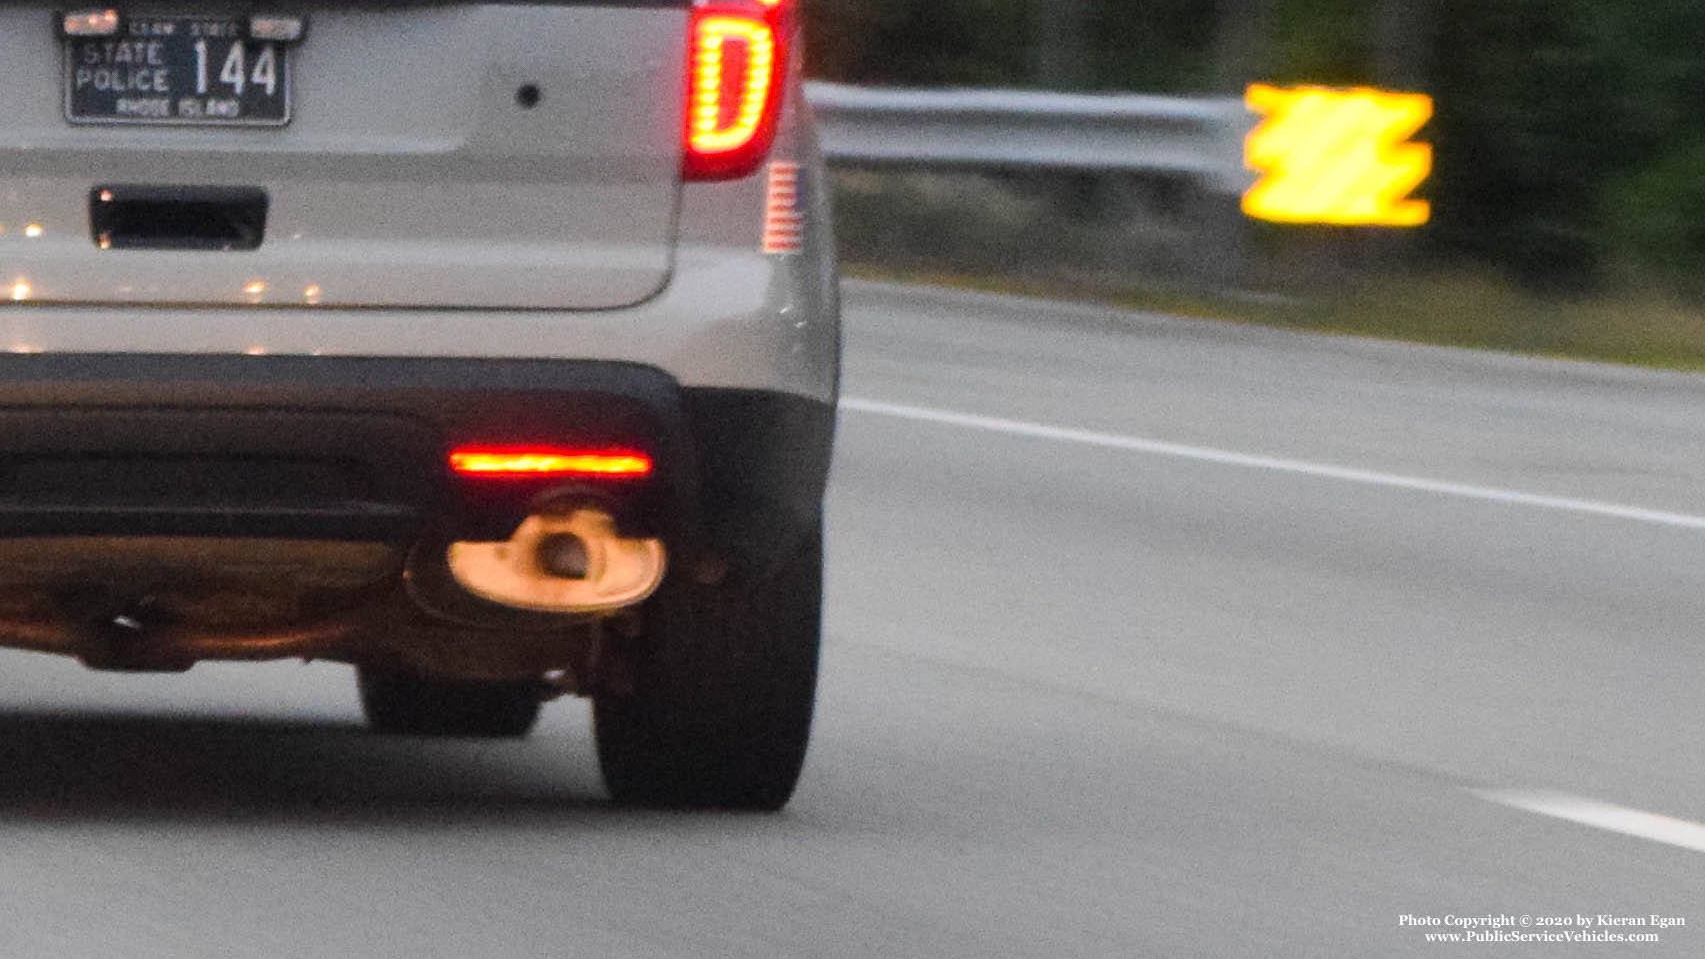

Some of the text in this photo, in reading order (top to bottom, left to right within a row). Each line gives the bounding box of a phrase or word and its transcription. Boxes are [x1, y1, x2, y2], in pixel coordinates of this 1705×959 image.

[75, 67, 170, 92] POLICE
[82, 39, 276, 96] STATE 144
[116, 97, 241, 117] RHODE ISLAND
